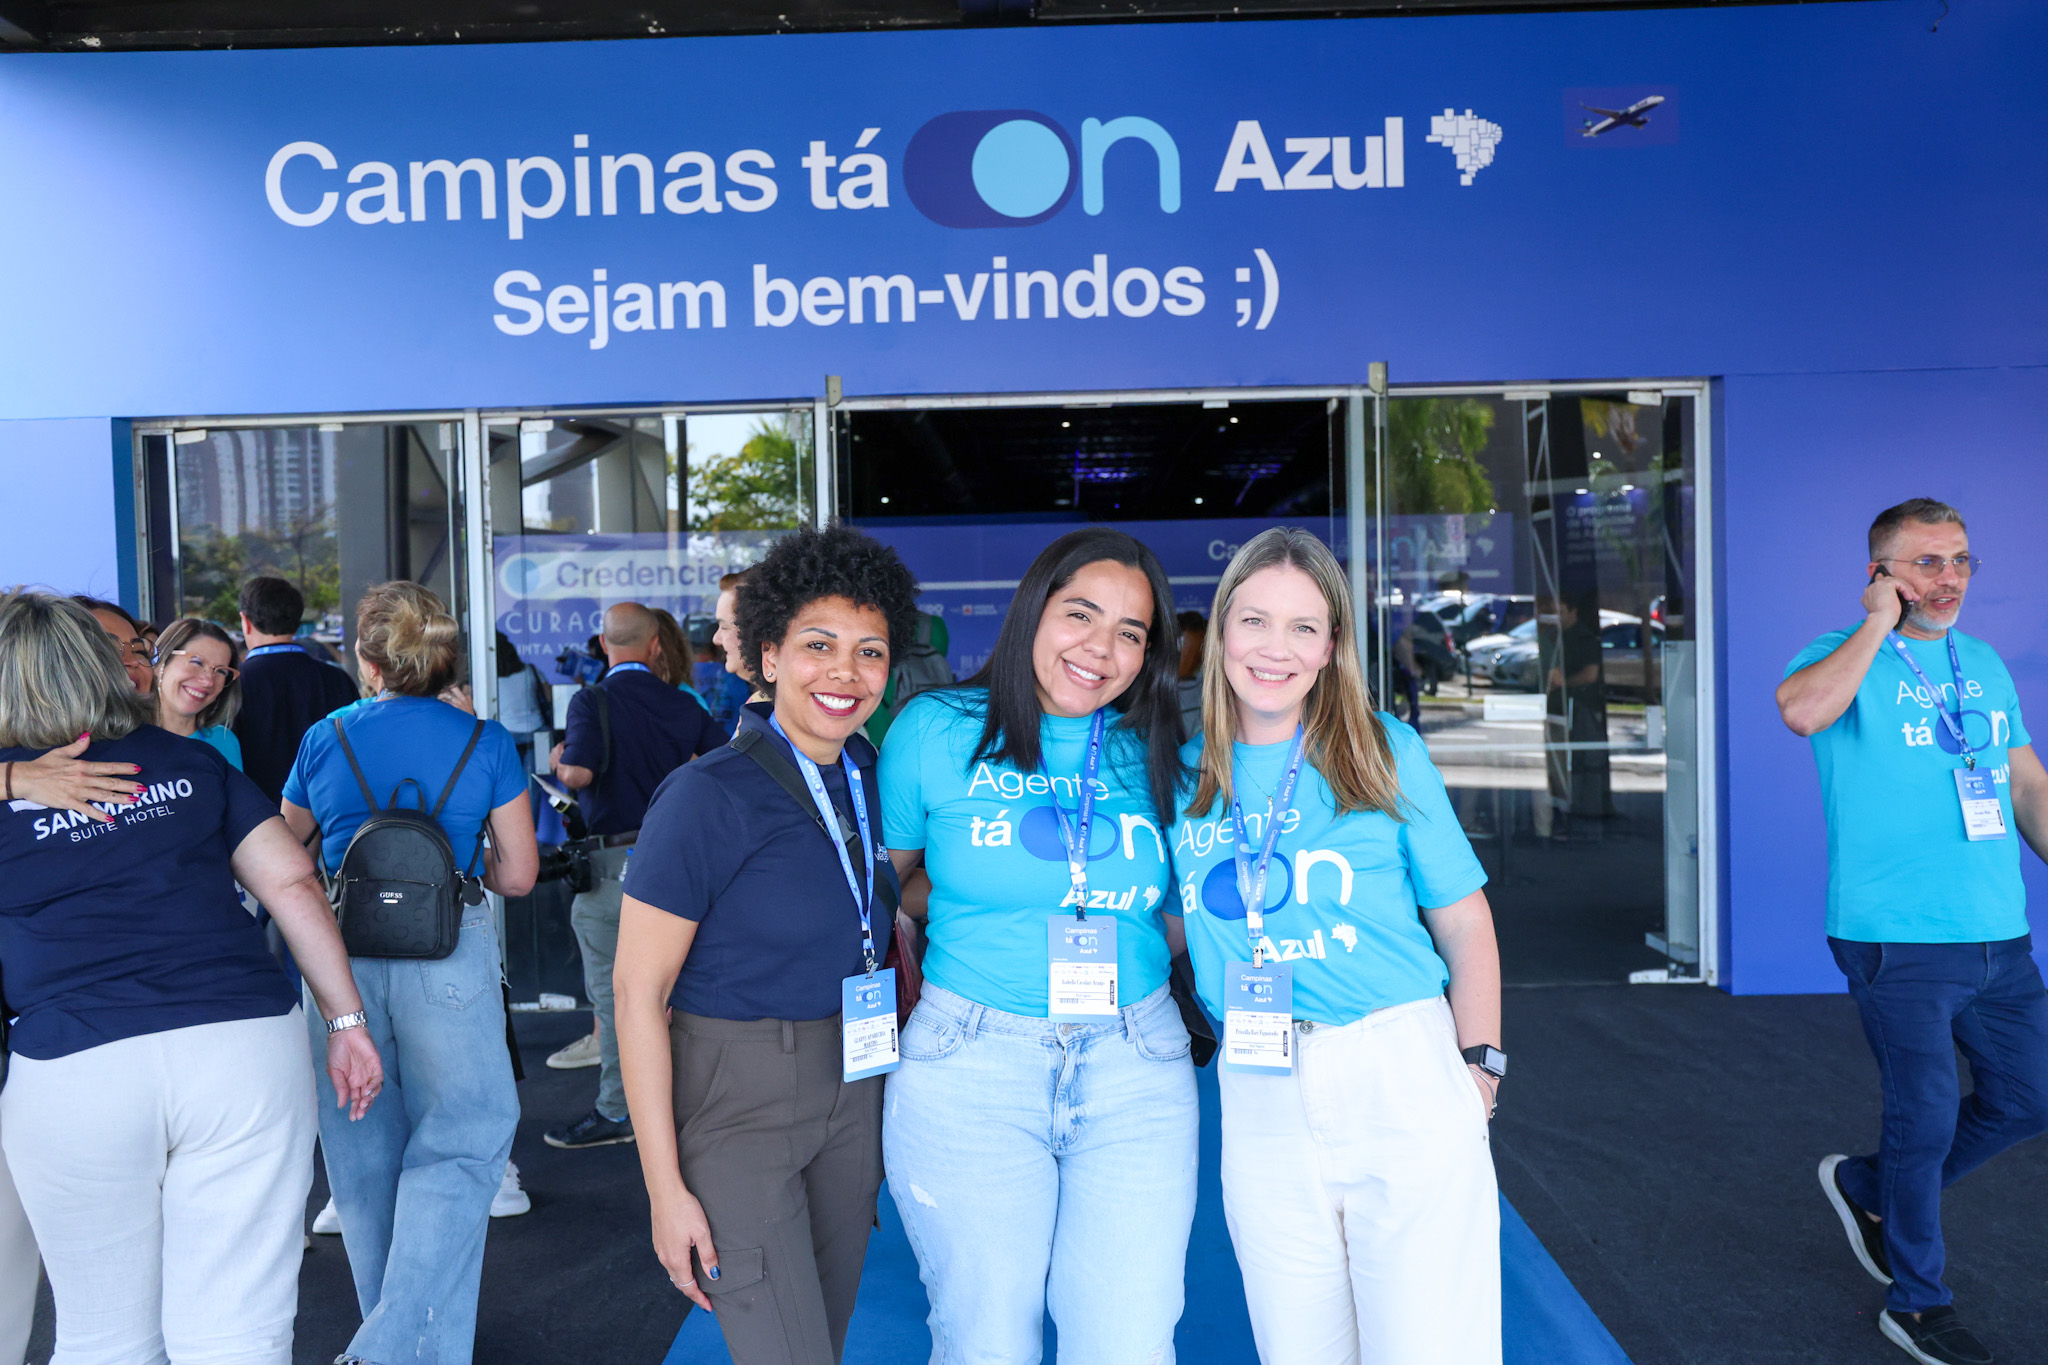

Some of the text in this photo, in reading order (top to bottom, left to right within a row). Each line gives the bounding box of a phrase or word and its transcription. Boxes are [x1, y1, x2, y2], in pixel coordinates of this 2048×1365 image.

[265, 133, 779, 240] Campinas
[801, 127, 889, 210] tá
[1214, 116, 1405, 193] Azul
[493, 267, 727, 350] Sejam
[753, 253, 1206, 328] bem-vindos
[1901, 717, 1934, 747] tá
[967, 762, 1110, 800] Agente
[32, 808, 90, 840] SAN
[70, 804, 176, 843] SUÍTE HOTEL
[970, 809, 1012, 847] tá
[1059, 885, 1138, 911] Azul
[1065, 927, 1098, 935] Campinas
[1257, 928, 1326, 964] Azul
[855, 982, 881, 992] Campinas
[1240, 974, 1273, 982] Campinas
